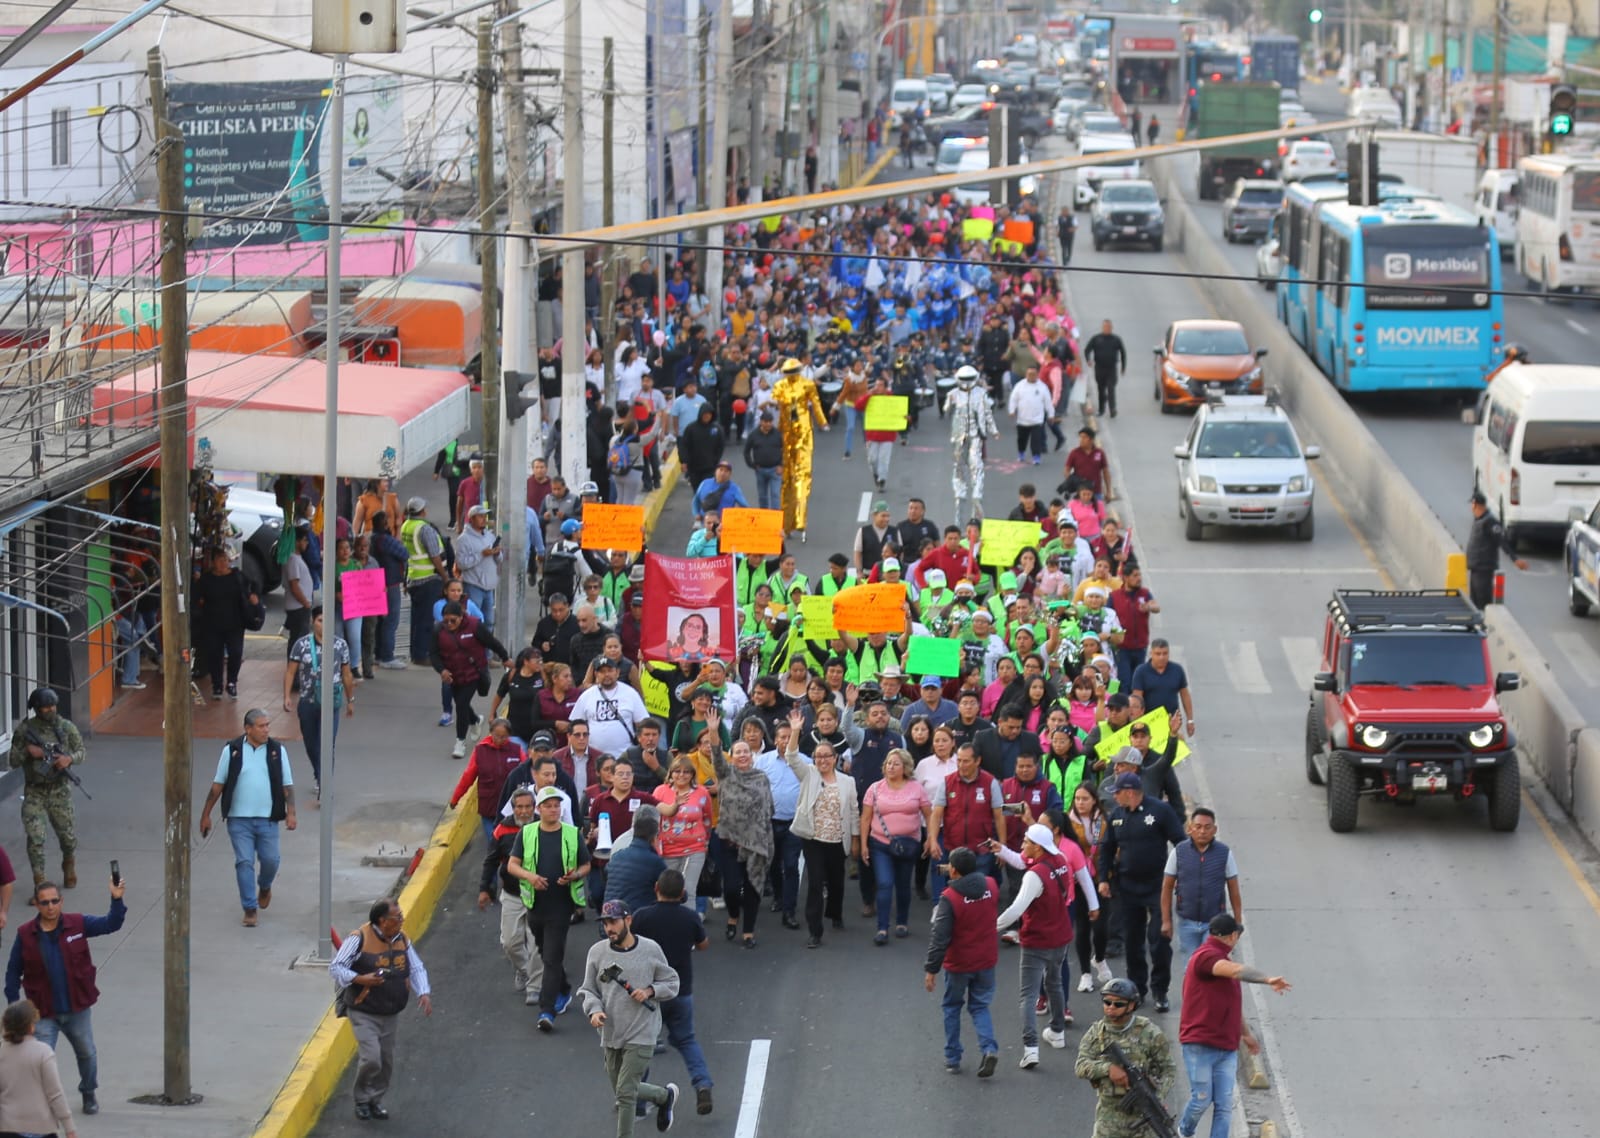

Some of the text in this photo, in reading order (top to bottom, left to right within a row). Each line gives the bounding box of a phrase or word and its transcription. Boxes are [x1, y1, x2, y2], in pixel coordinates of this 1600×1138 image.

[178, 114, 316, 137] CHELSEA PEERS
[195, 147, 229, 157] Idiomas
[195, 161, 242, 174] Pasaportes
[248, 159, 266, 169] Visa
[1415, 257, 1479, 273] Mexibús
[1377, 326, 1480, 345] MOVIMEX
[688, 559, 728, 571] DIAMANTES
